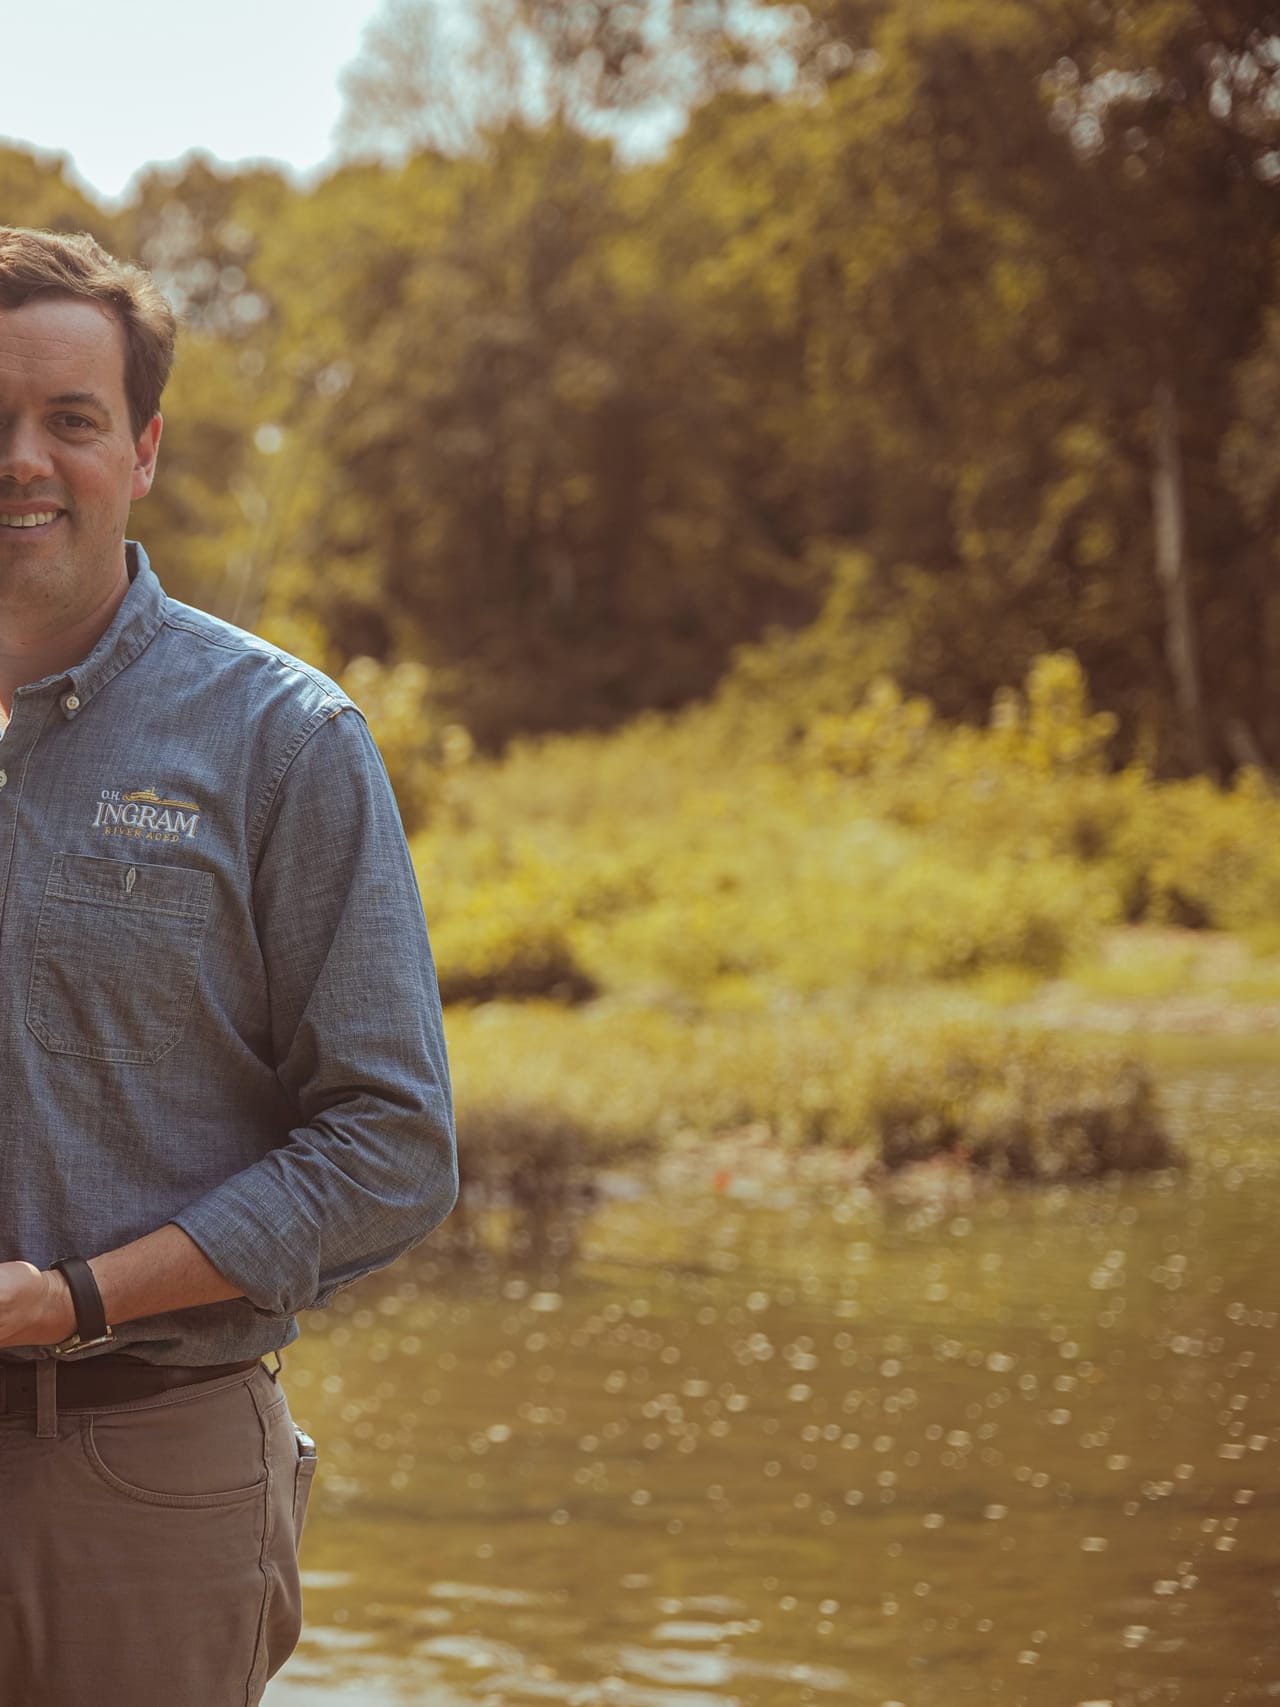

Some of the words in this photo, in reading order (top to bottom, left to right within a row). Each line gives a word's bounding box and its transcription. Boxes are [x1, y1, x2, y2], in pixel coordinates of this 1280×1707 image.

[92, 802, 200, 838] INGRAM
[104, 826, 141, 838] RIVER
[145, 832, 180, 842] AGED
